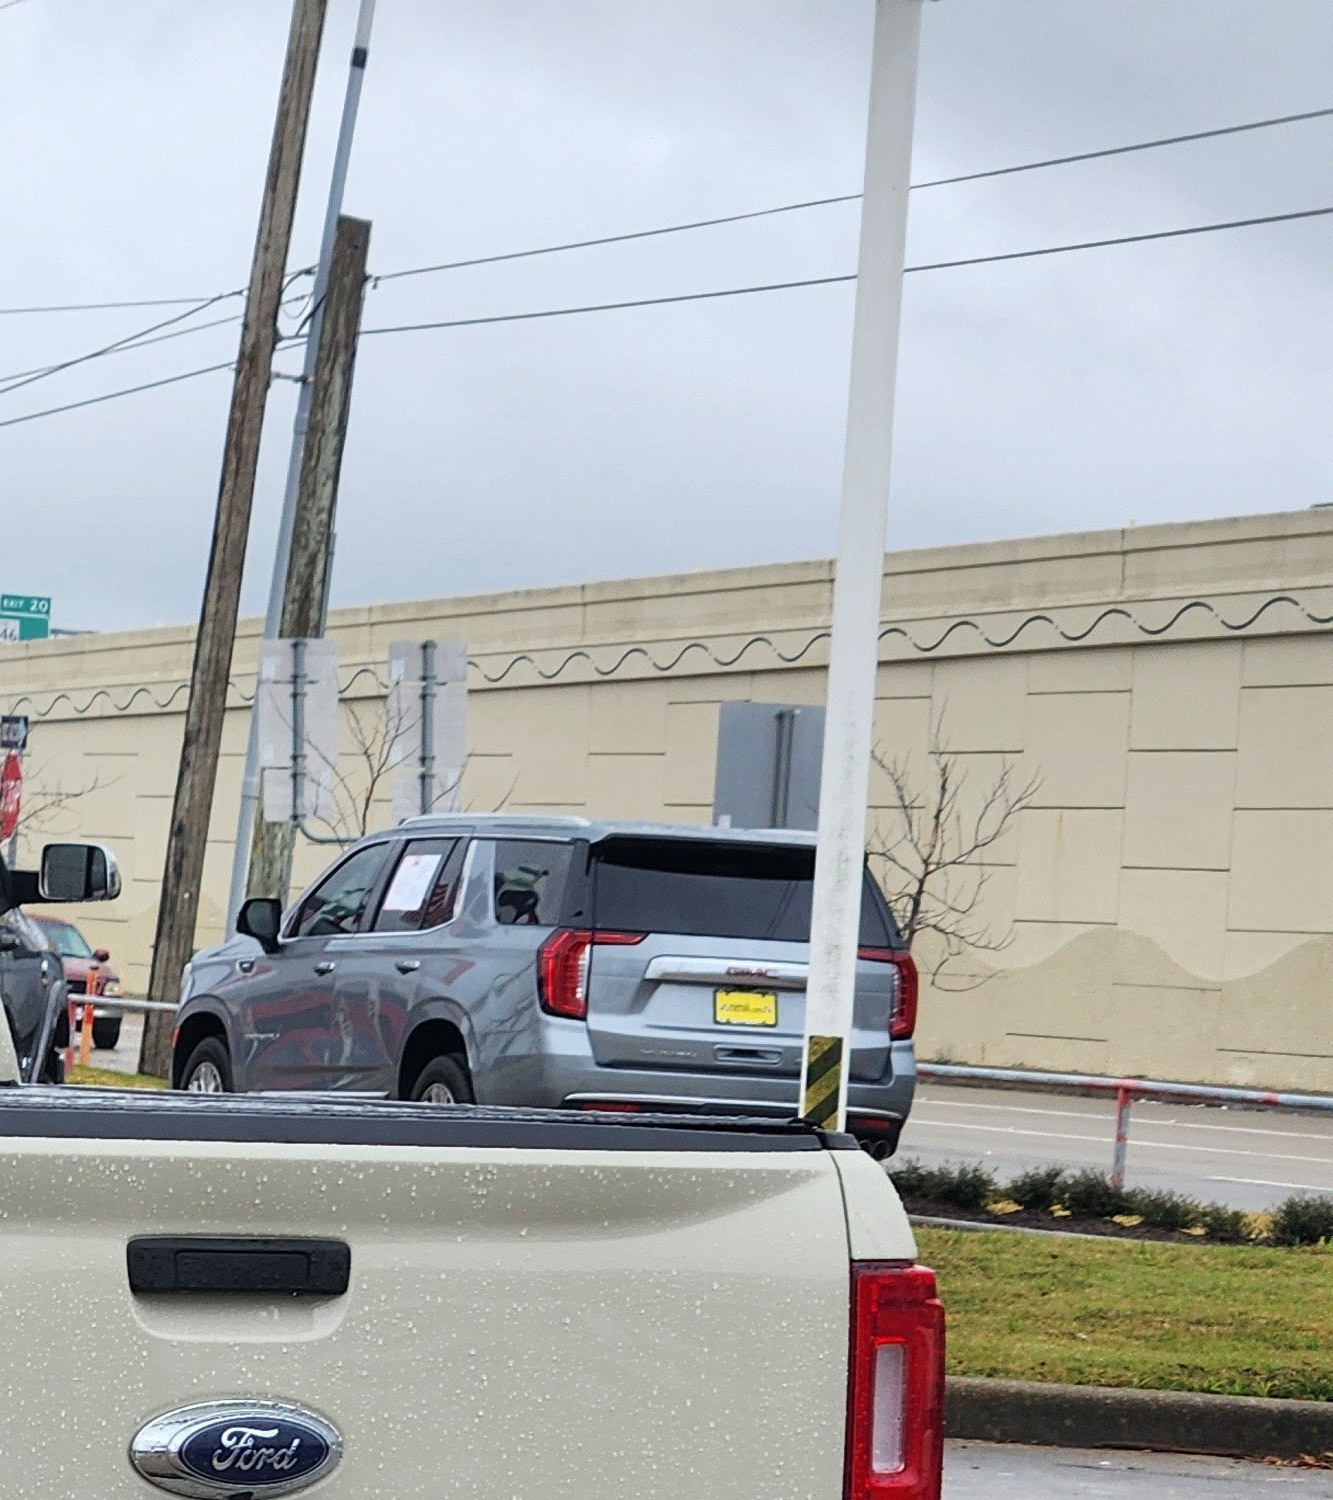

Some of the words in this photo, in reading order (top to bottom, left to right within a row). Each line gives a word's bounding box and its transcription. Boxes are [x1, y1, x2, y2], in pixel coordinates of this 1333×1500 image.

[2, 598, 25, 609] EXIT
[30, 600, 49, 612] 20
[211, 1426, 301, 1472] Ford
